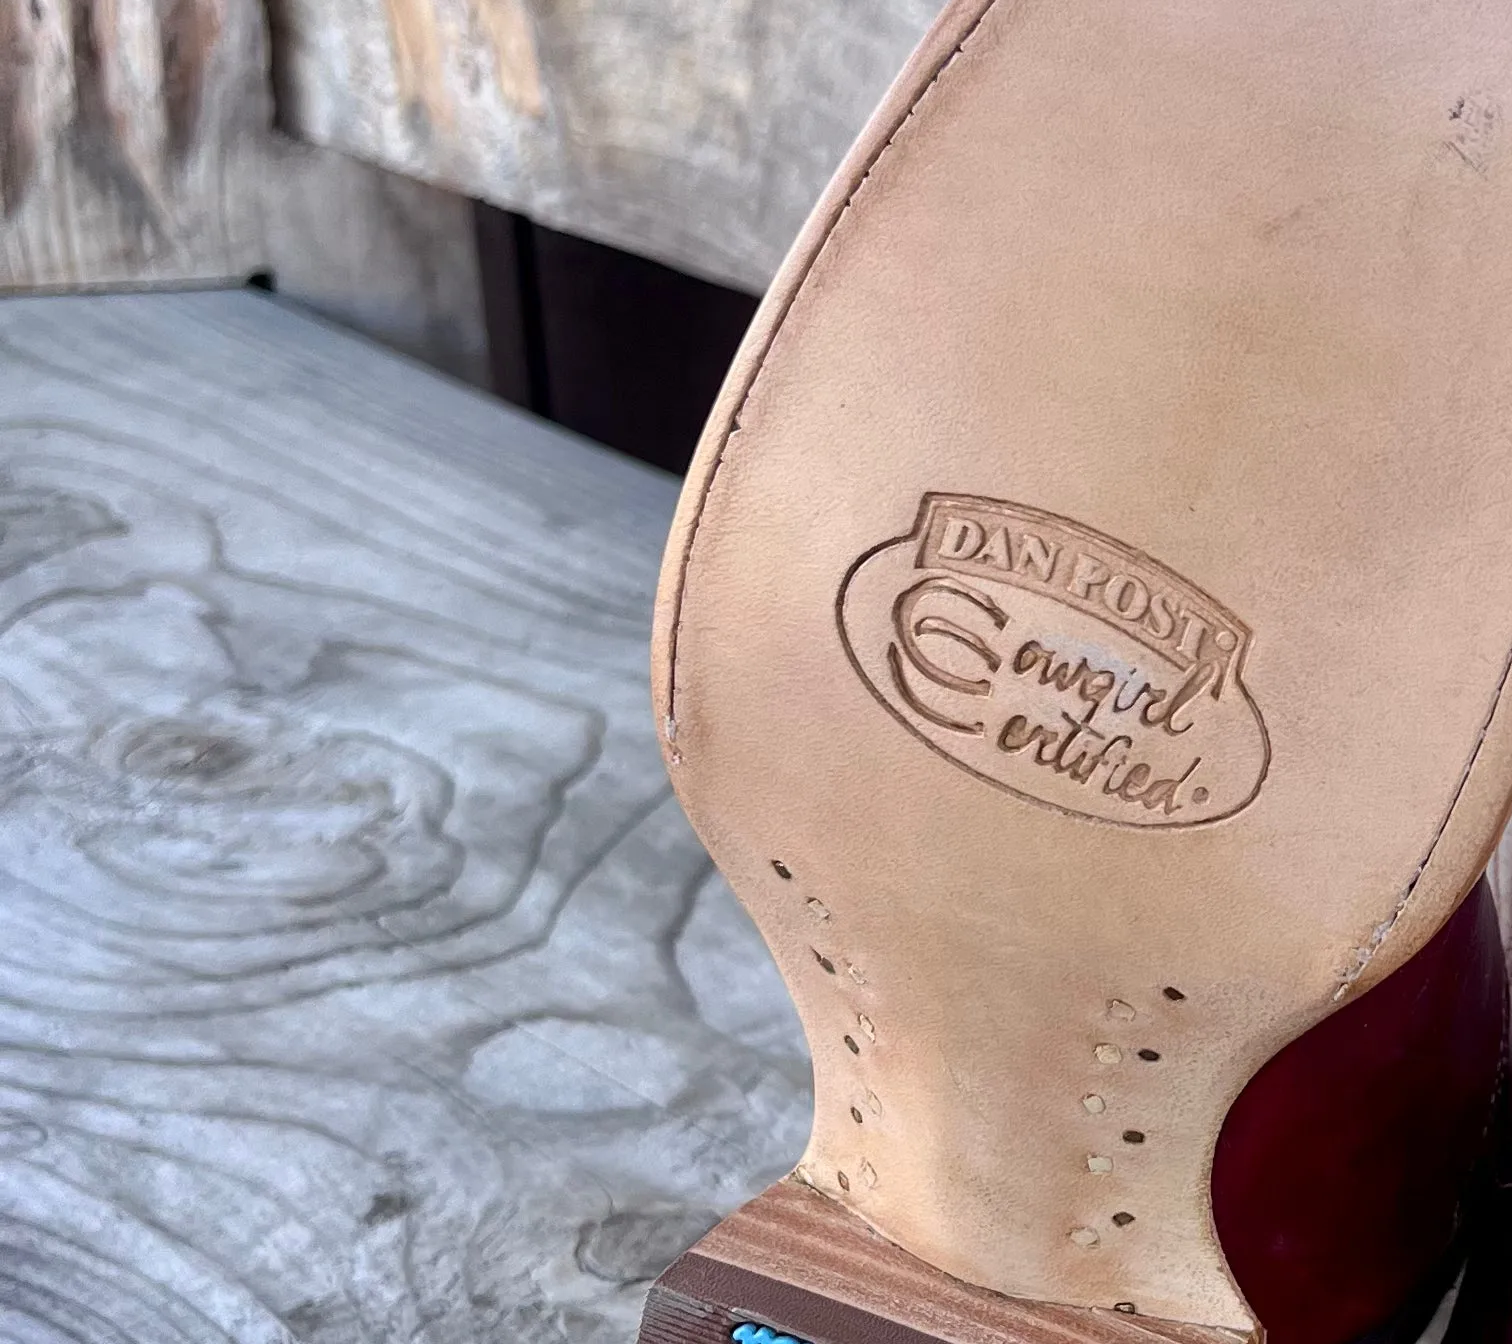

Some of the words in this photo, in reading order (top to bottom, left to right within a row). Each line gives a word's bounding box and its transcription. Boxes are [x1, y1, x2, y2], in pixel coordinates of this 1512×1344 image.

[892, 576, 1223, 737] Cowgirl
[937, 517, 1062, 583] DAN
[1066, 552, 1215, 659] POST
[887, 616, 1202, 815] Certified
